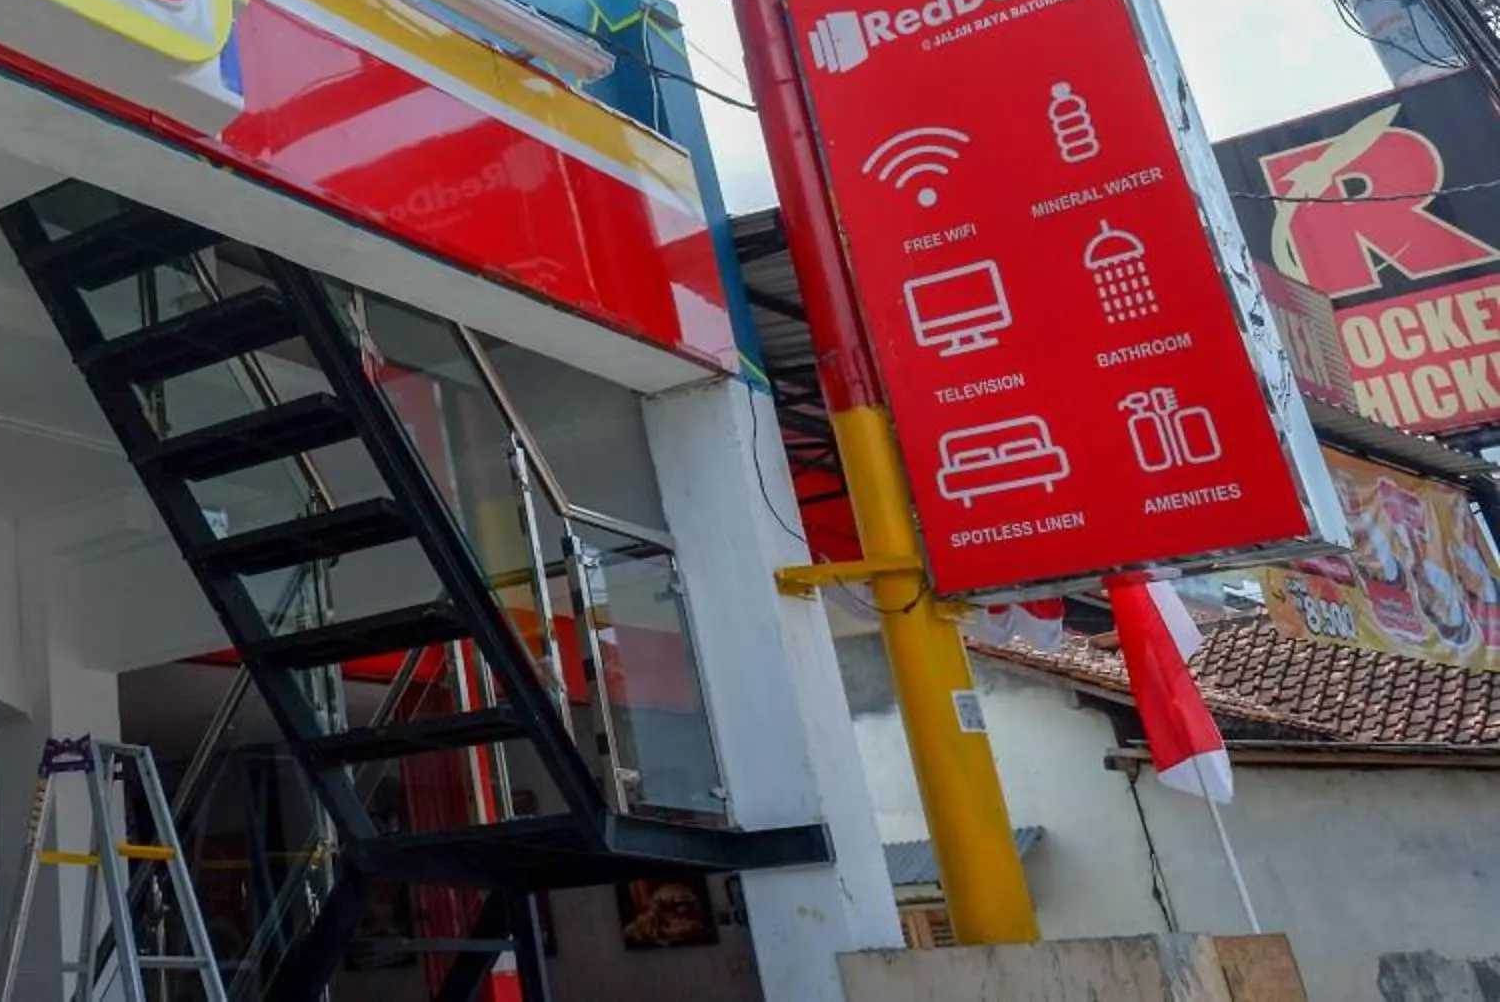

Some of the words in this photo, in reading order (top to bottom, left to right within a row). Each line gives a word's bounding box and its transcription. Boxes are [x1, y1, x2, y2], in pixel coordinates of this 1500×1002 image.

[933, 24, 972, 47] JALAN
[974, 9, 1009, 32] RAYA
[1031, 187, 1103, 219] MINERAL
[1105, 167, 1163, 196] WATER
[903, 232, 942, 254] FREE
[945, 223, 978, 246] WIFI
[1342, 285, 1500, 369] OCKE
[1097, 333, 1192, 368] BATHROOM
[934, 373, 1026, 405] TELEVISION
[1144, 483, 1242, 516] AMENITIES
[951, 520, 1033, 548] SPOTLESS
[1036, 512, 1085, 535] LINEN
